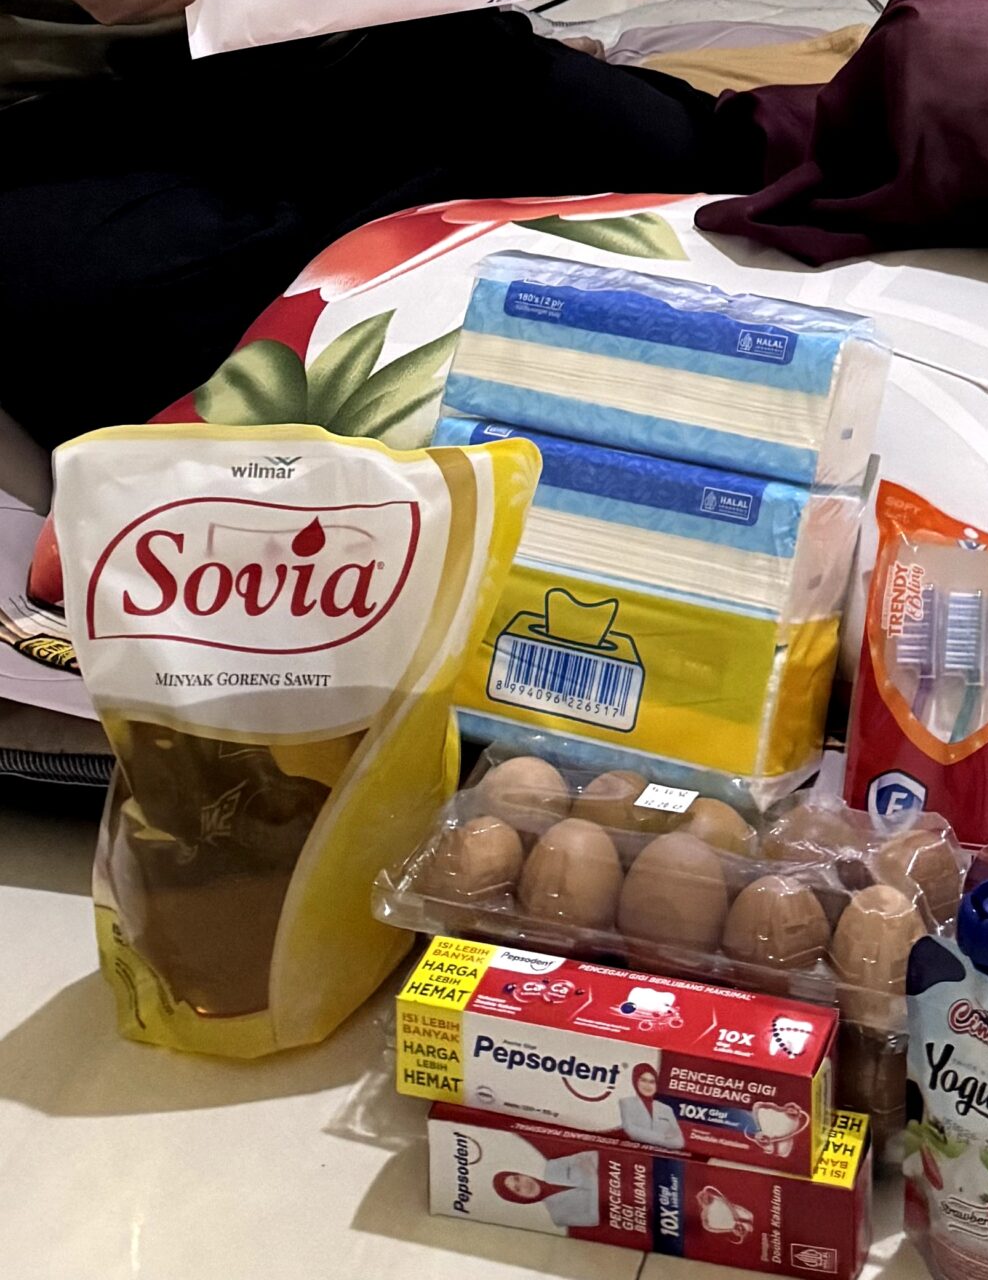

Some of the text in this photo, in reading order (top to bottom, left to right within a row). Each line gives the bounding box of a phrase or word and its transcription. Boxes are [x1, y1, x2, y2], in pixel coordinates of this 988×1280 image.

[755, 336, 784, 349] HALAL
[230, 462, 296, 480] wilmar
[719, 495, 749, 509] HALAL
[121, 517, 381, 618] Sovia
[887, 563, 909, 638] TRENDY
[155, 671, 332, 688] MINYAK GORENG SAWIT
[509, 684, 561, 704] 994096
[567, 698, 619, 718] 226517
[431, 948, 485, 965] BANYAK
[437, 941, 490, 957] ISI LEBIH
[500, 951, 555, 968] Pepsodent
[421, 959, 478, 979] HARGA
[578, 963, 628, 978] PENCEGAH
[428, 974, 461, 986] LEBIH
[406, 981, 472, 1003] HEMAT
[402, 1012, 461, 1032] ISI LEBIH
[402, 1024, 461, 1044] BANYAK
[717, 1028, 756, 1047] 10X
[402, 1040, 461, 1063] HARGA
[473, 1035, 621, 1086] Pepsodent
[416, 1059, 448, 1072] LEBIH
[404, 1069, 464, 1094] HEMAT
[668, 1079, 751, 1104] BERLUBANG
[669, 1067, 776, 1097] PENCEGAH GIGI
[677, 1103, 709, 1121] 10X
[453, 1131, 471, 1214] Pepsodent
[608, 1160, 622, 1229] PENCEGAH
[632, 1164, 647, 1233] BERLUBANG
[622, 1205, 634, 1232] GIGI
[659, 1208, 680, 1237] 10X
[770, 1185, 782, 1265] Double Kalsium
